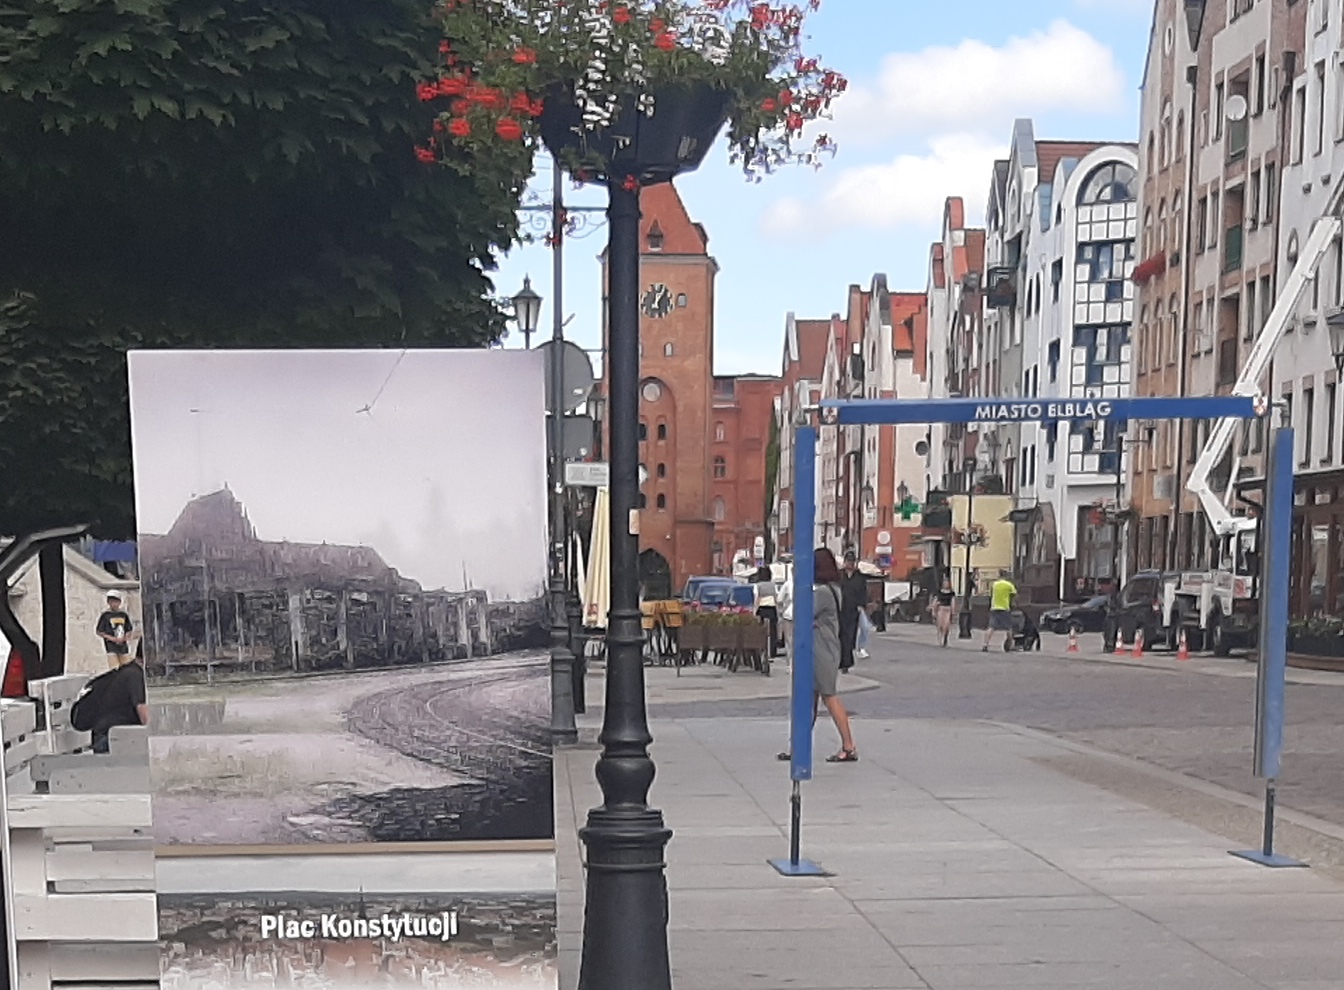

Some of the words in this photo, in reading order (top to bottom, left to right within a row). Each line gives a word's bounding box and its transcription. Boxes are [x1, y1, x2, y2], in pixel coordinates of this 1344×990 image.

[976, 403, 1042, 419] MIASTO
[1047, 401, 1112, 420] ELBLĄG
[260, 913, 316, 939] Plac
[321, 911, 458, 942] Konstytucji
